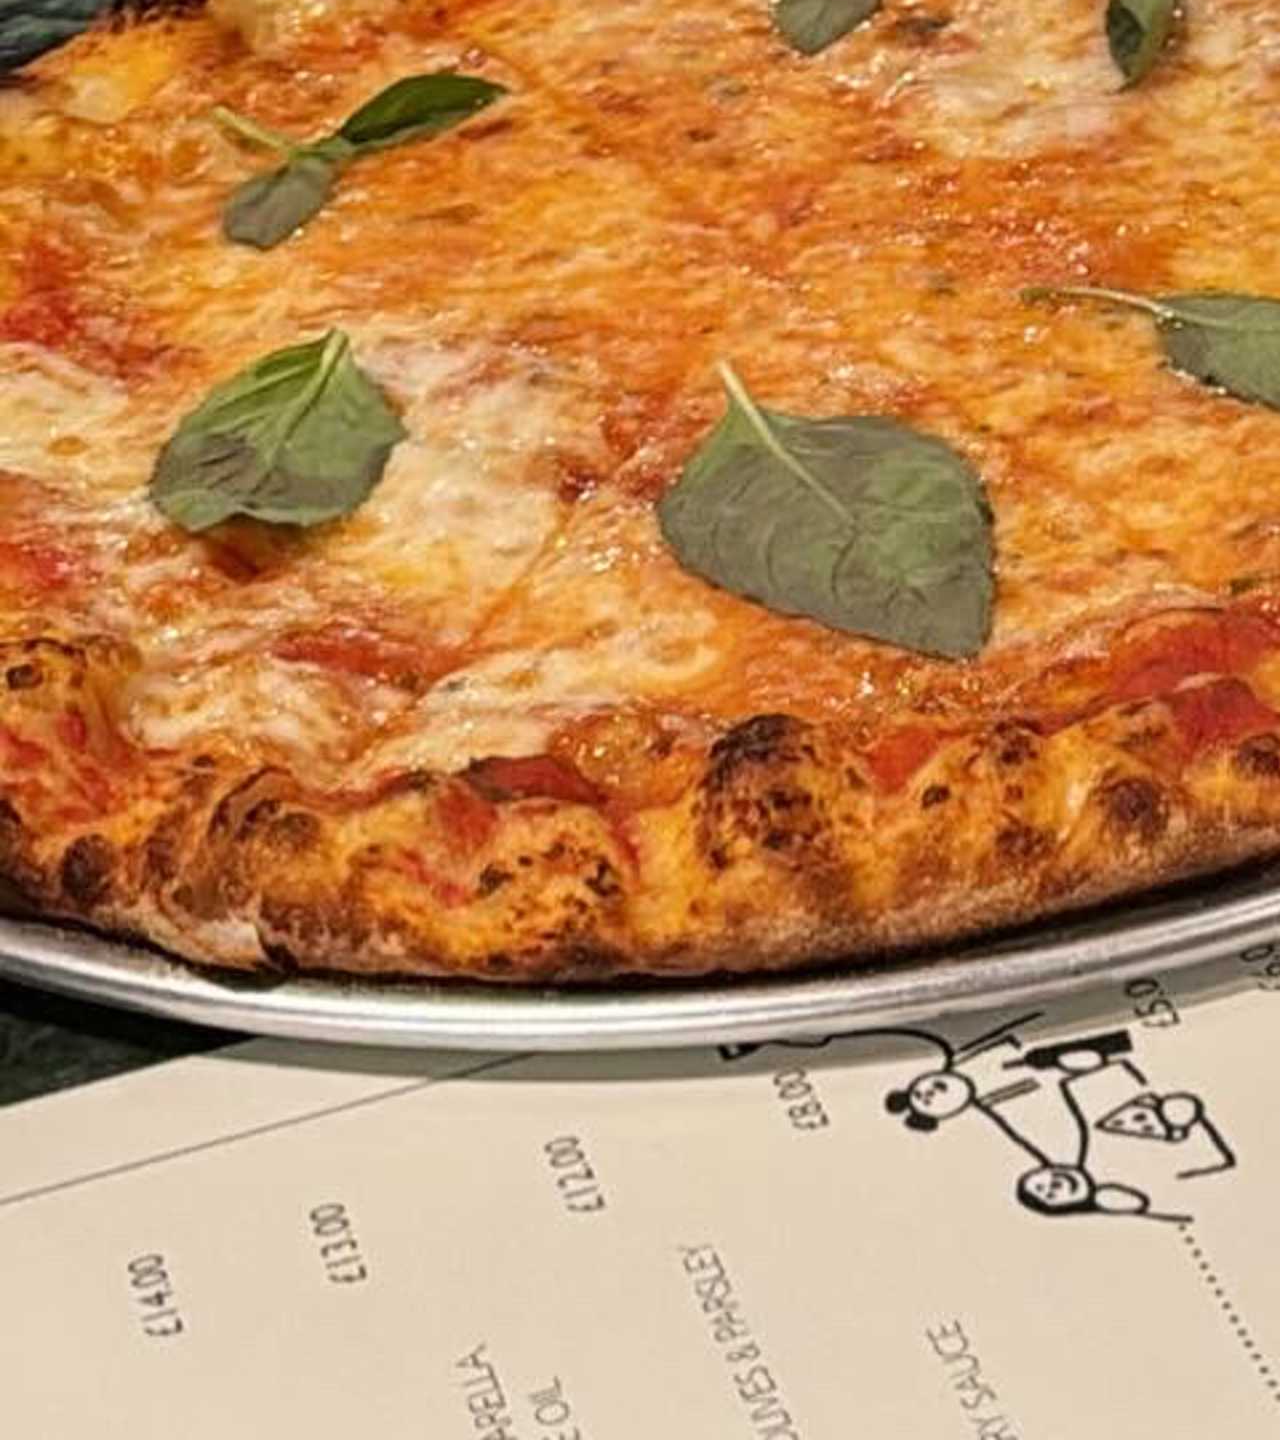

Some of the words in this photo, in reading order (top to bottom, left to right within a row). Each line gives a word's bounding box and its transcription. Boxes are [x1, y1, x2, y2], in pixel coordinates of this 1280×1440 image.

[773, 1065, 830, 1131] £8.00
[543, 1135, 606, 1213] £12.00
[308, 1203, 368, 1284] £13.00
[127, 1253, 185, 1338] £14.00
[678, 1244, 750, 1338] PARSLEY
[726, 1340, 761, 1363] &
[926, 1319, 998, 1410] SAUCE
[528, 1375, 571, 1426] OIL
